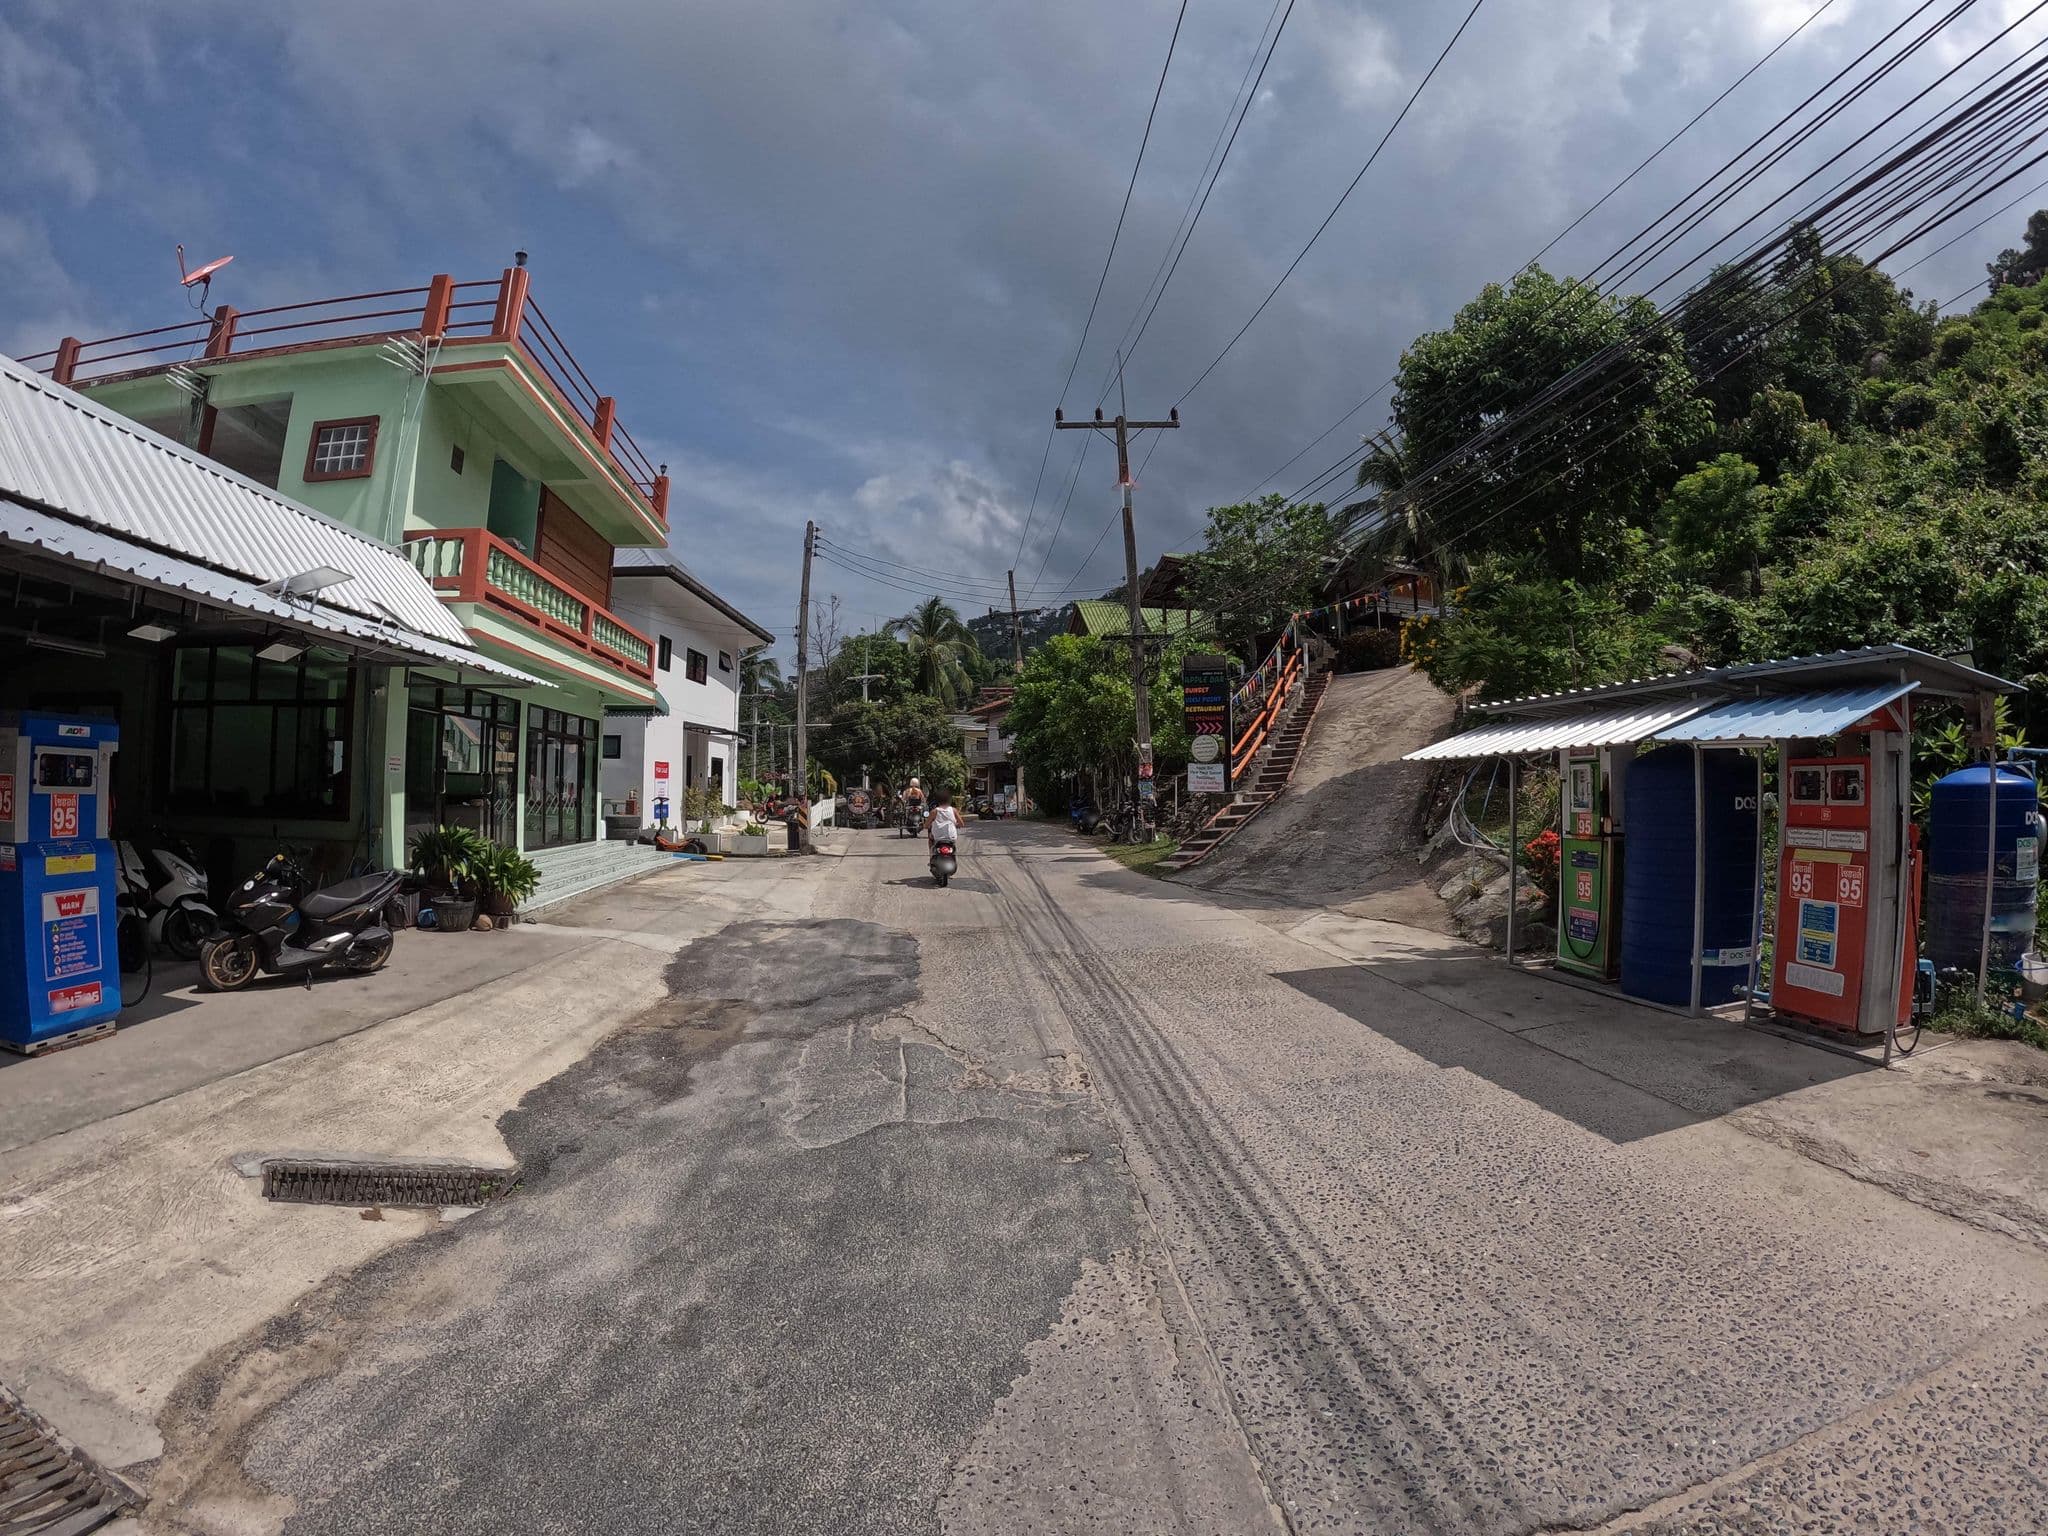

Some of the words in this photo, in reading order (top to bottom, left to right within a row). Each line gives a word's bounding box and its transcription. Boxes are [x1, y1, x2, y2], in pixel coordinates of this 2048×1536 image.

[1184, 705, 1226, 713] RESTAURANT
[1735, 796, 1757, 810] DOS
[53, 807, 76, 830] 95
[1578, 820, 1591, 834] 95
[1578, 882, 1591, 897] 95
[1792, 873, 1812, 893] 95
[1839, 878, 1861, 900] 95
